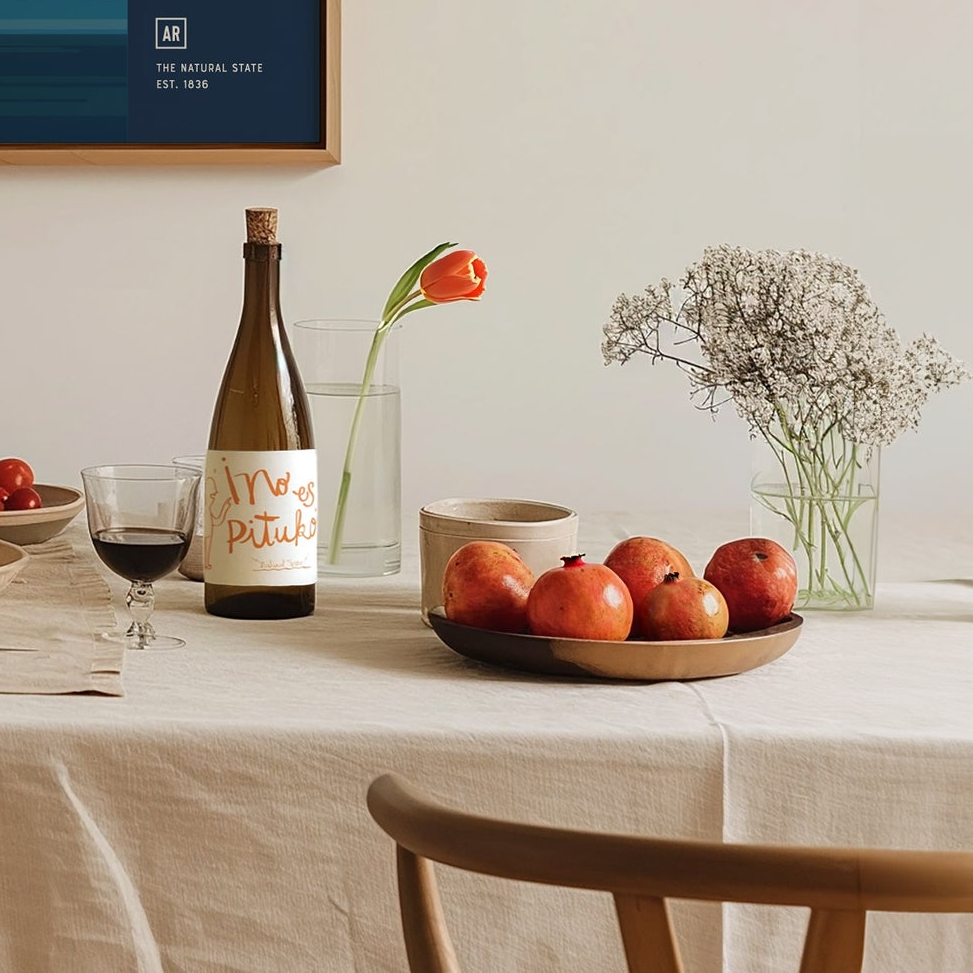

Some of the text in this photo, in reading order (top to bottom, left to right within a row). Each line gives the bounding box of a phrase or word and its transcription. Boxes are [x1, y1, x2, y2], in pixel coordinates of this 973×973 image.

[162, 25, 181, 42] AR
[155, 62, 263, 73] THE NATURAL STATE
[156, 79, 209, 90] EST. 1836
[292, 481, 315, 507] es
